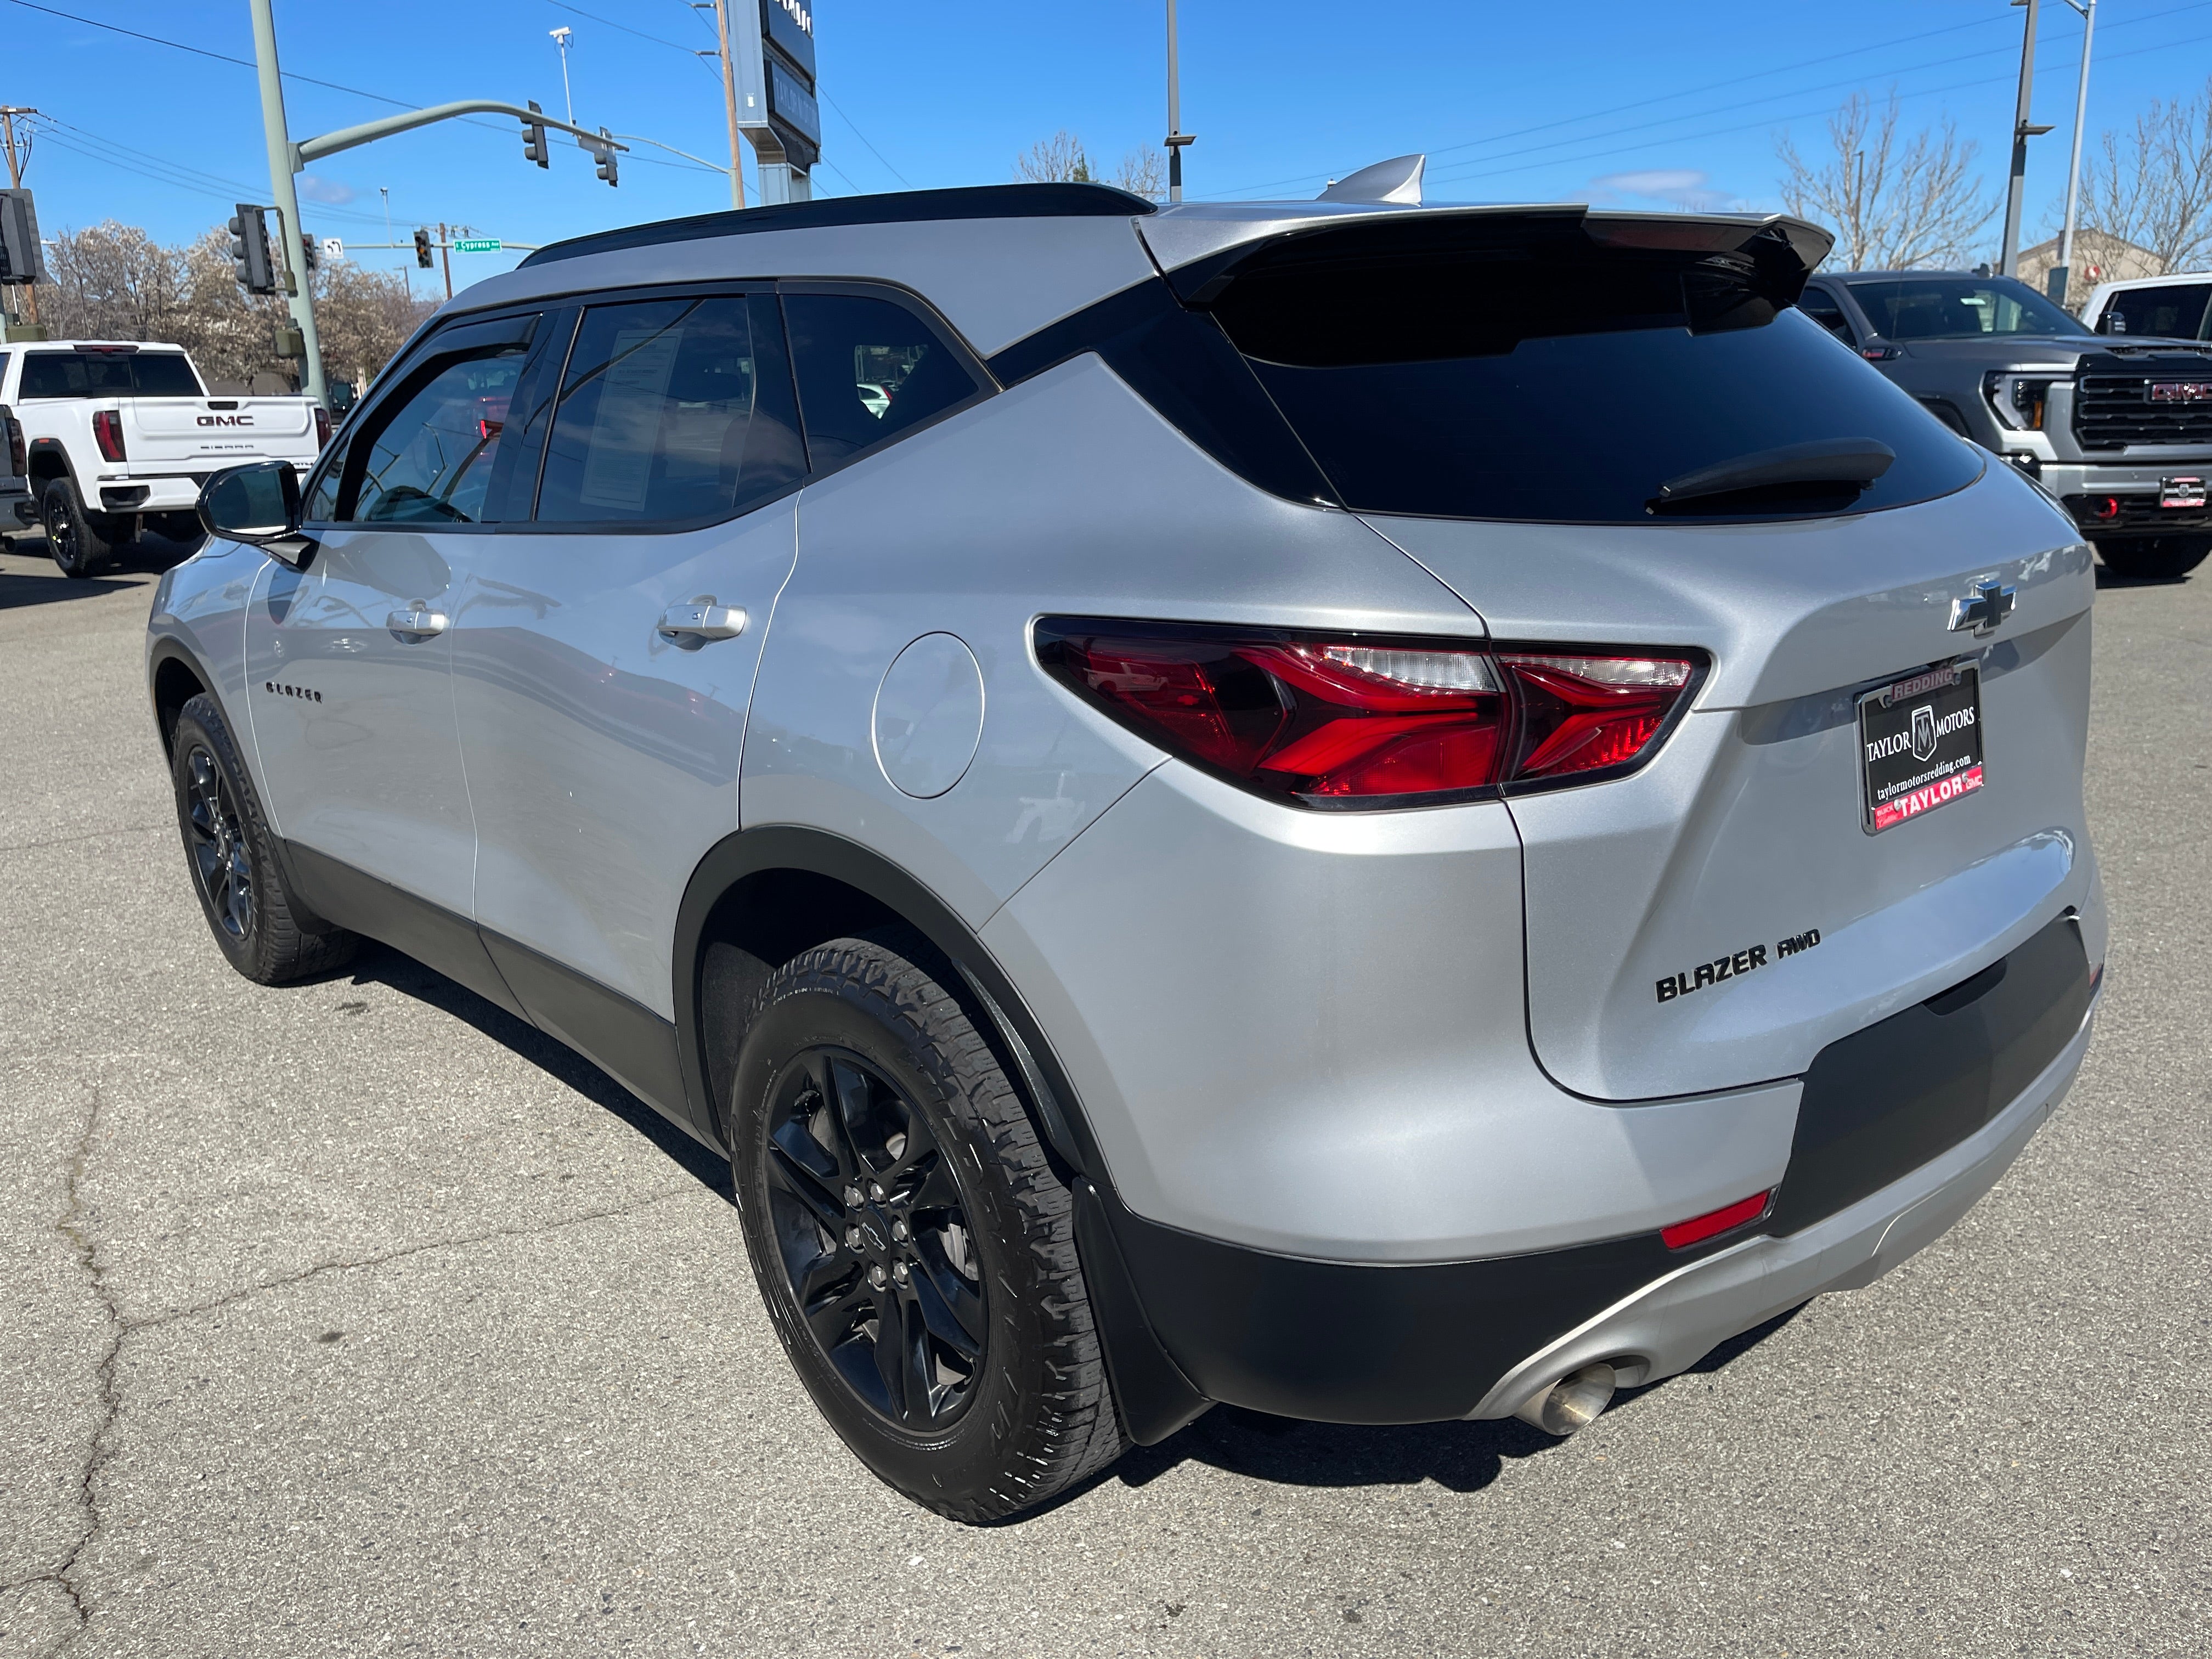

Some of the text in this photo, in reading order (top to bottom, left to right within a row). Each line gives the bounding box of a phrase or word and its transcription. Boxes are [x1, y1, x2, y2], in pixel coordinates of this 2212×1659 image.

[461, 241, 490, 250] Cypress
[197, 416, 253, 426] GMC
[266, 681, 323, 704] BLAZER
[1894, 669, 1954, 699] REDDING
[1866, 731, 1912, 762] TAYLOR
[1936, 706, 1975, 737] MOTORS
[1877, 755, 1971, 800] taylormotorsredding.com
[1898, 776, 1963, 817] TAYLOR
[1656, 929, 1821, 1003] BLAZER AWD
